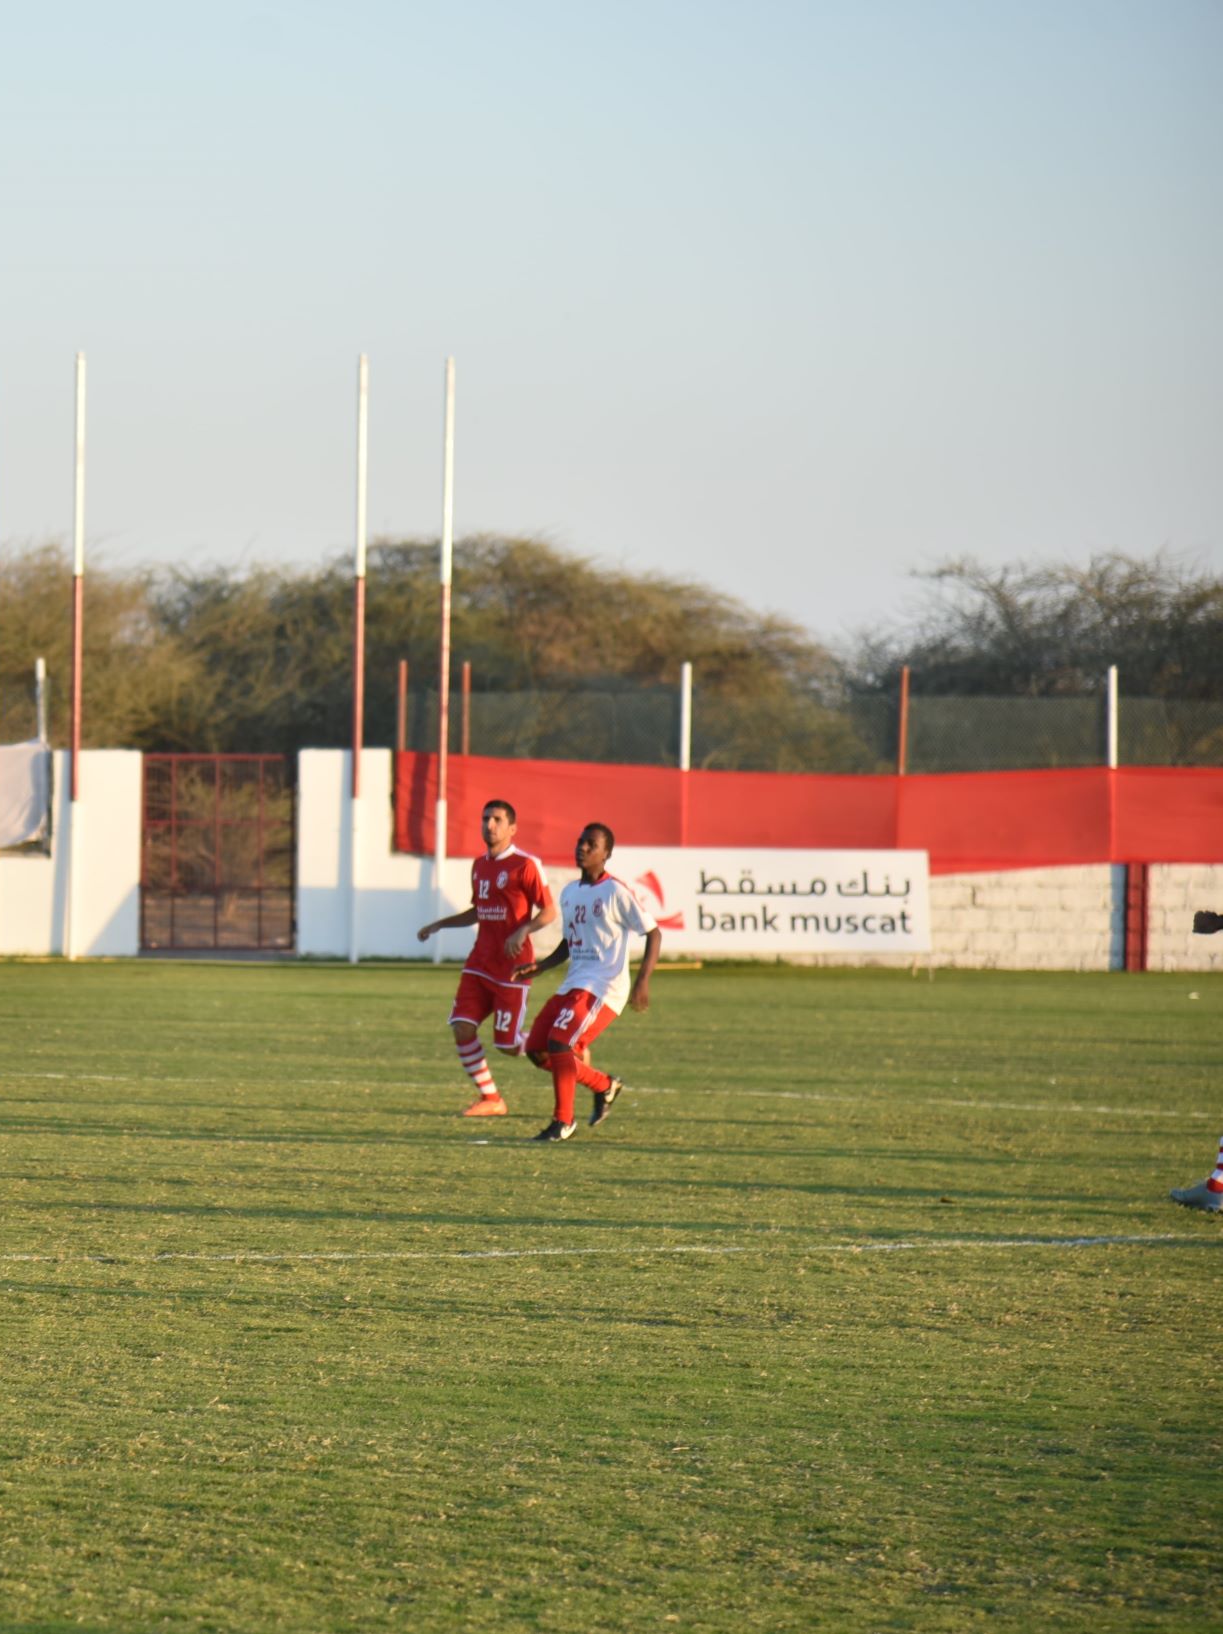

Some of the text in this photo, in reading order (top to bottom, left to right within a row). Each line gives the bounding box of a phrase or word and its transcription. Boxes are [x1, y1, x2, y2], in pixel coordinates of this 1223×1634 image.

[479, 880, 490, 899] 12
[696, 870, 912, 904] بنك مسقط
[575, 904, 586, 924] 22
[698, 904, 912, 934] bank muscat
[495, 1009, 512, 1032] 12
[553, 1007, 575, 1031] 22
